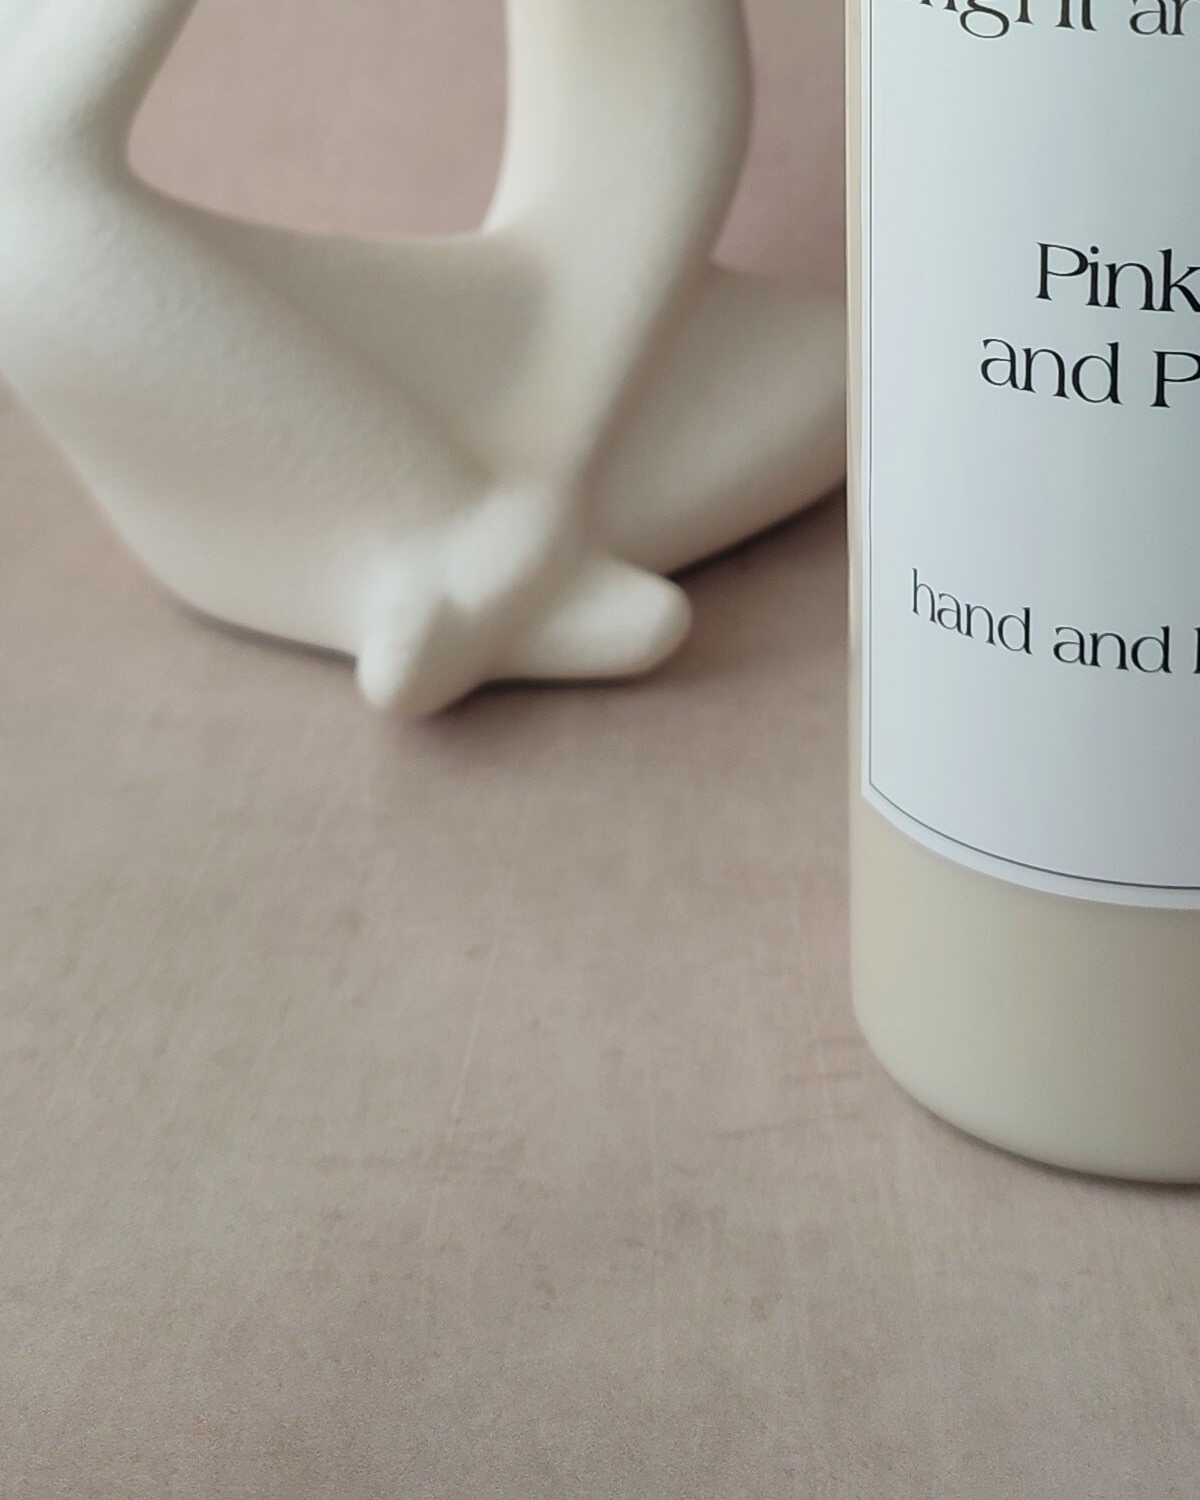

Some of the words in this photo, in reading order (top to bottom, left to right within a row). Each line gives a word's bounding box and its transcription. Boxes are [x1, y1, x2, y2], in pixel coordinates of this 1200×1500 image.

[980, 336, 1123, 406] and
[910, 567, 1033, 656] hand
[1053, 625, 1172, 674] and
